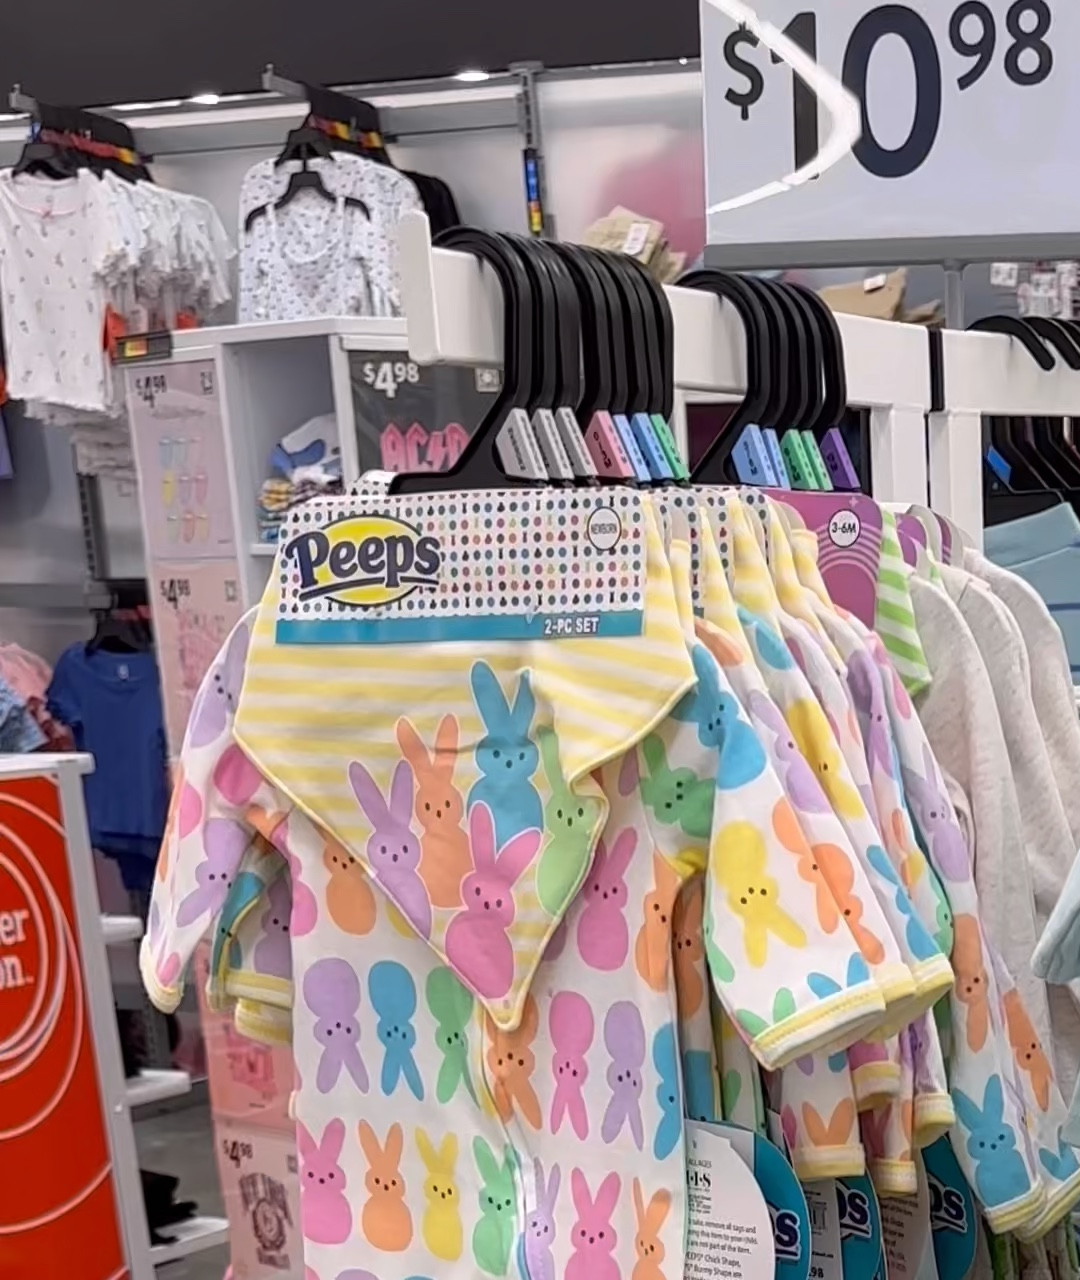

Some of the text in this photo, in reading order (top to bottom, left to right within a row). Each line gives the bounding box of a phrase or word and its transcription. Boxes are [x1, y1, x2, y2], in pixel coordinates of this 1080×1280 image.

[363, 362, 420, 398] $498
[831, 521, 857, 534] 3-6M
[285, 530, 441, 589] Peeps
[544, 616, 599, 636] 2-PC SET
